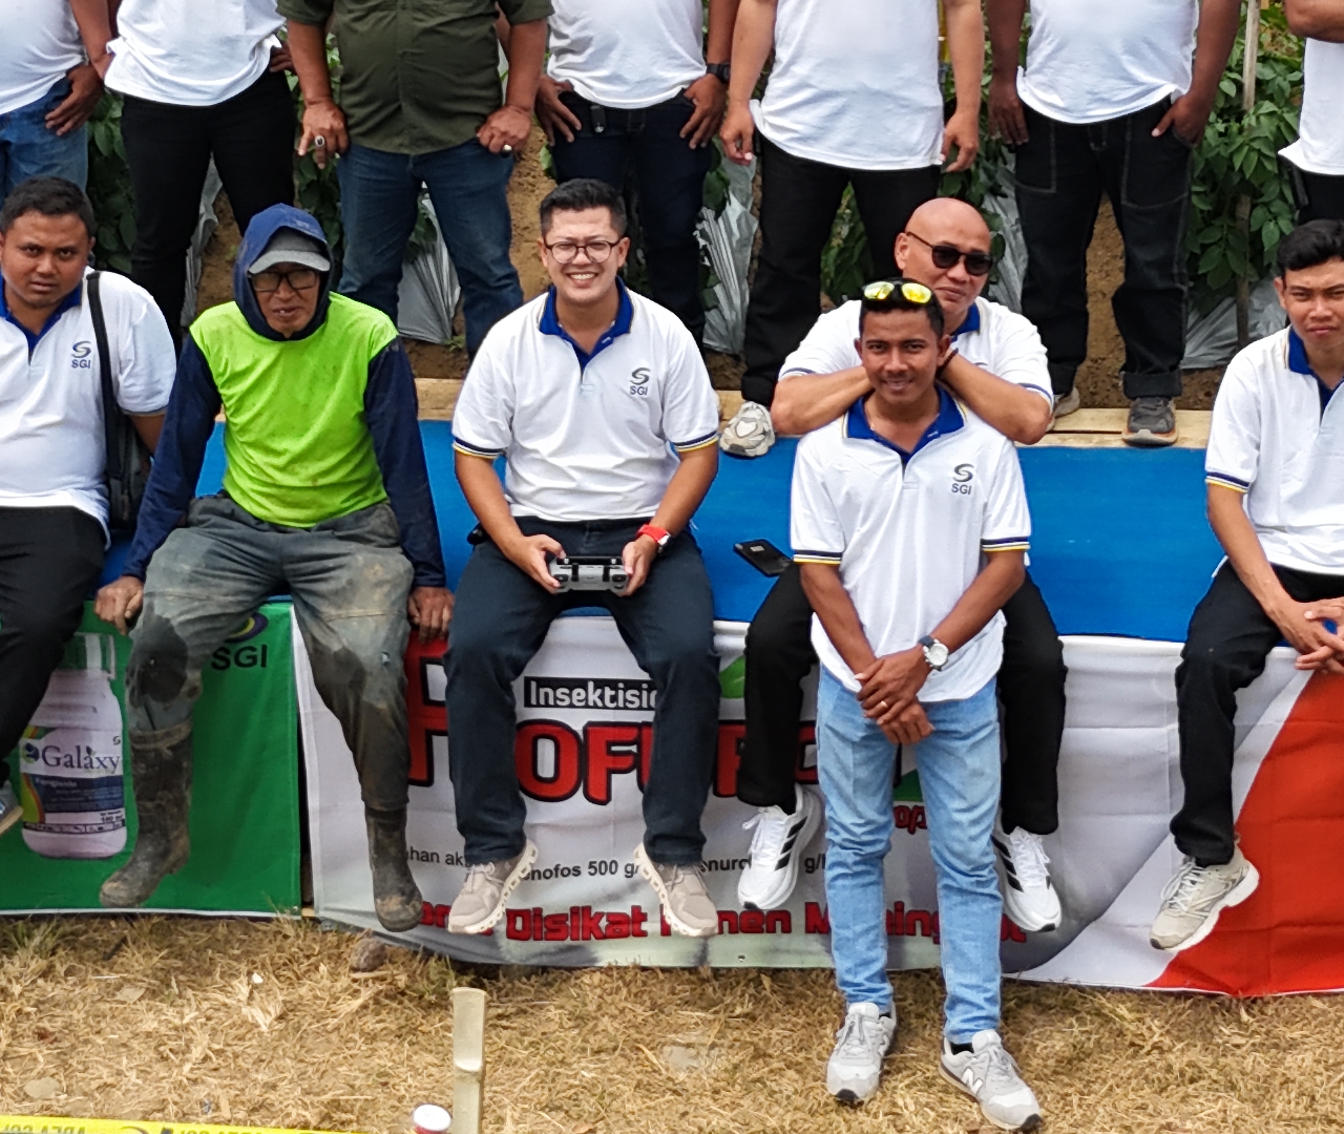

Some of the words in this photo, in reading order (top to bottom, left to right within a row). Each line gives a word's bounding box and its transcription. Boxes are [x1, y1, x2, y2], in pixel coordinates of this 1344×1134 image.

[71, 359, 91, 369] SGI
[629, 386, 649, 396] SGI
[951, 483, 972, 495] SGI
[211, 646, 268, 671] SGI
[42, 745, 121, 774] Galaxy
[587, 860, 619, 877] 500
[505, 904, 648, 942] Disikat
